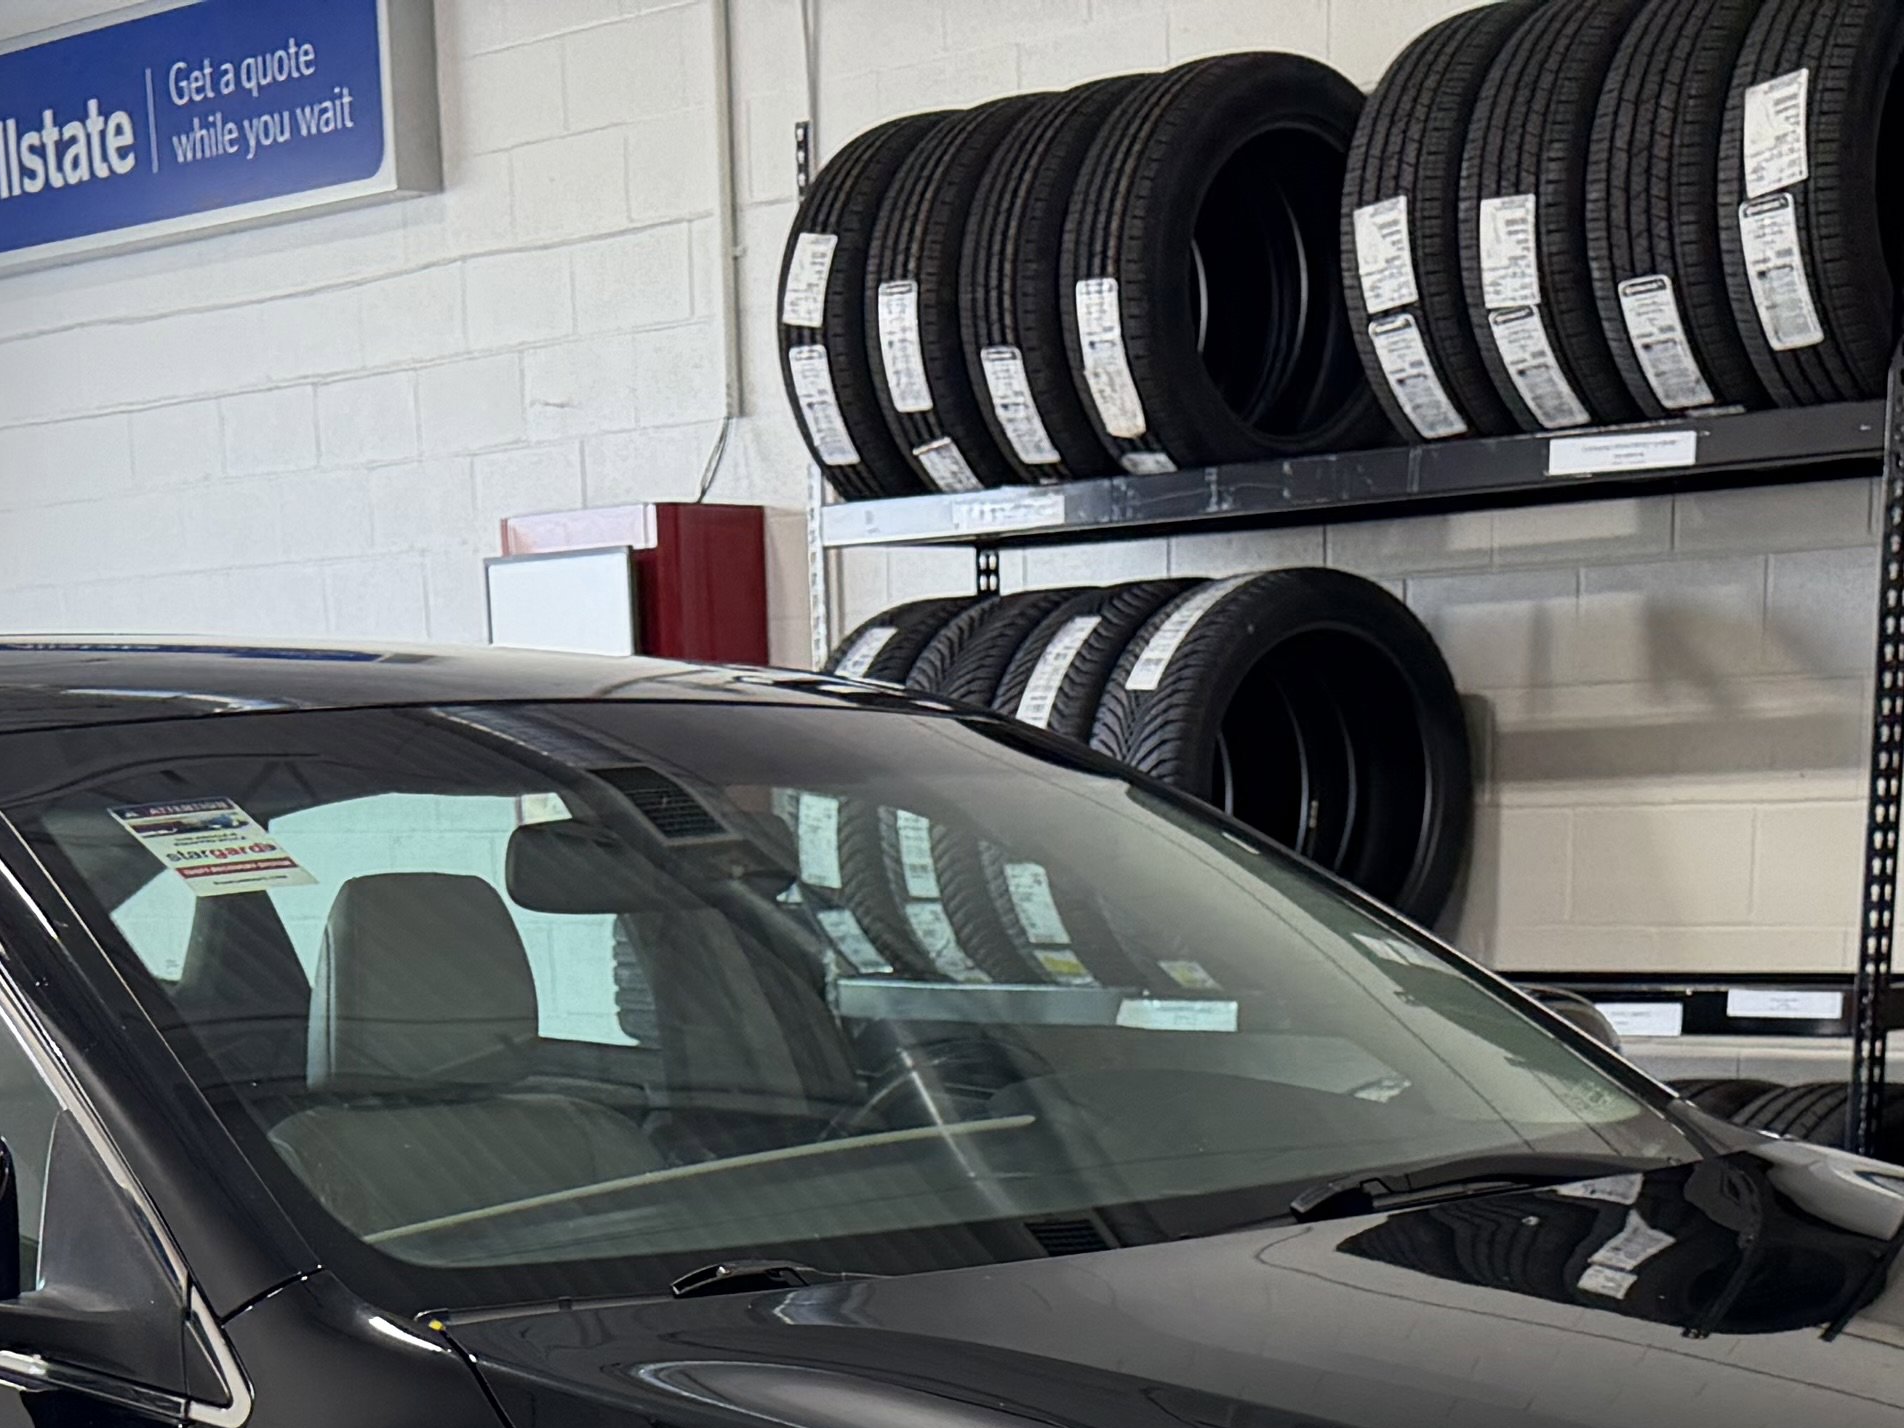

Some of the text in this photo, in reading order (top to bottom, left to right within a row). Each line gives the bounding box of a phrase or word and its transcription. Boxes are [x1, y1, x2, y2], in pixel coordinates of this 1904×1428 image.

[168, 37, 317, 106] Get a quote
[172, 86, 355, 165] while you wait
